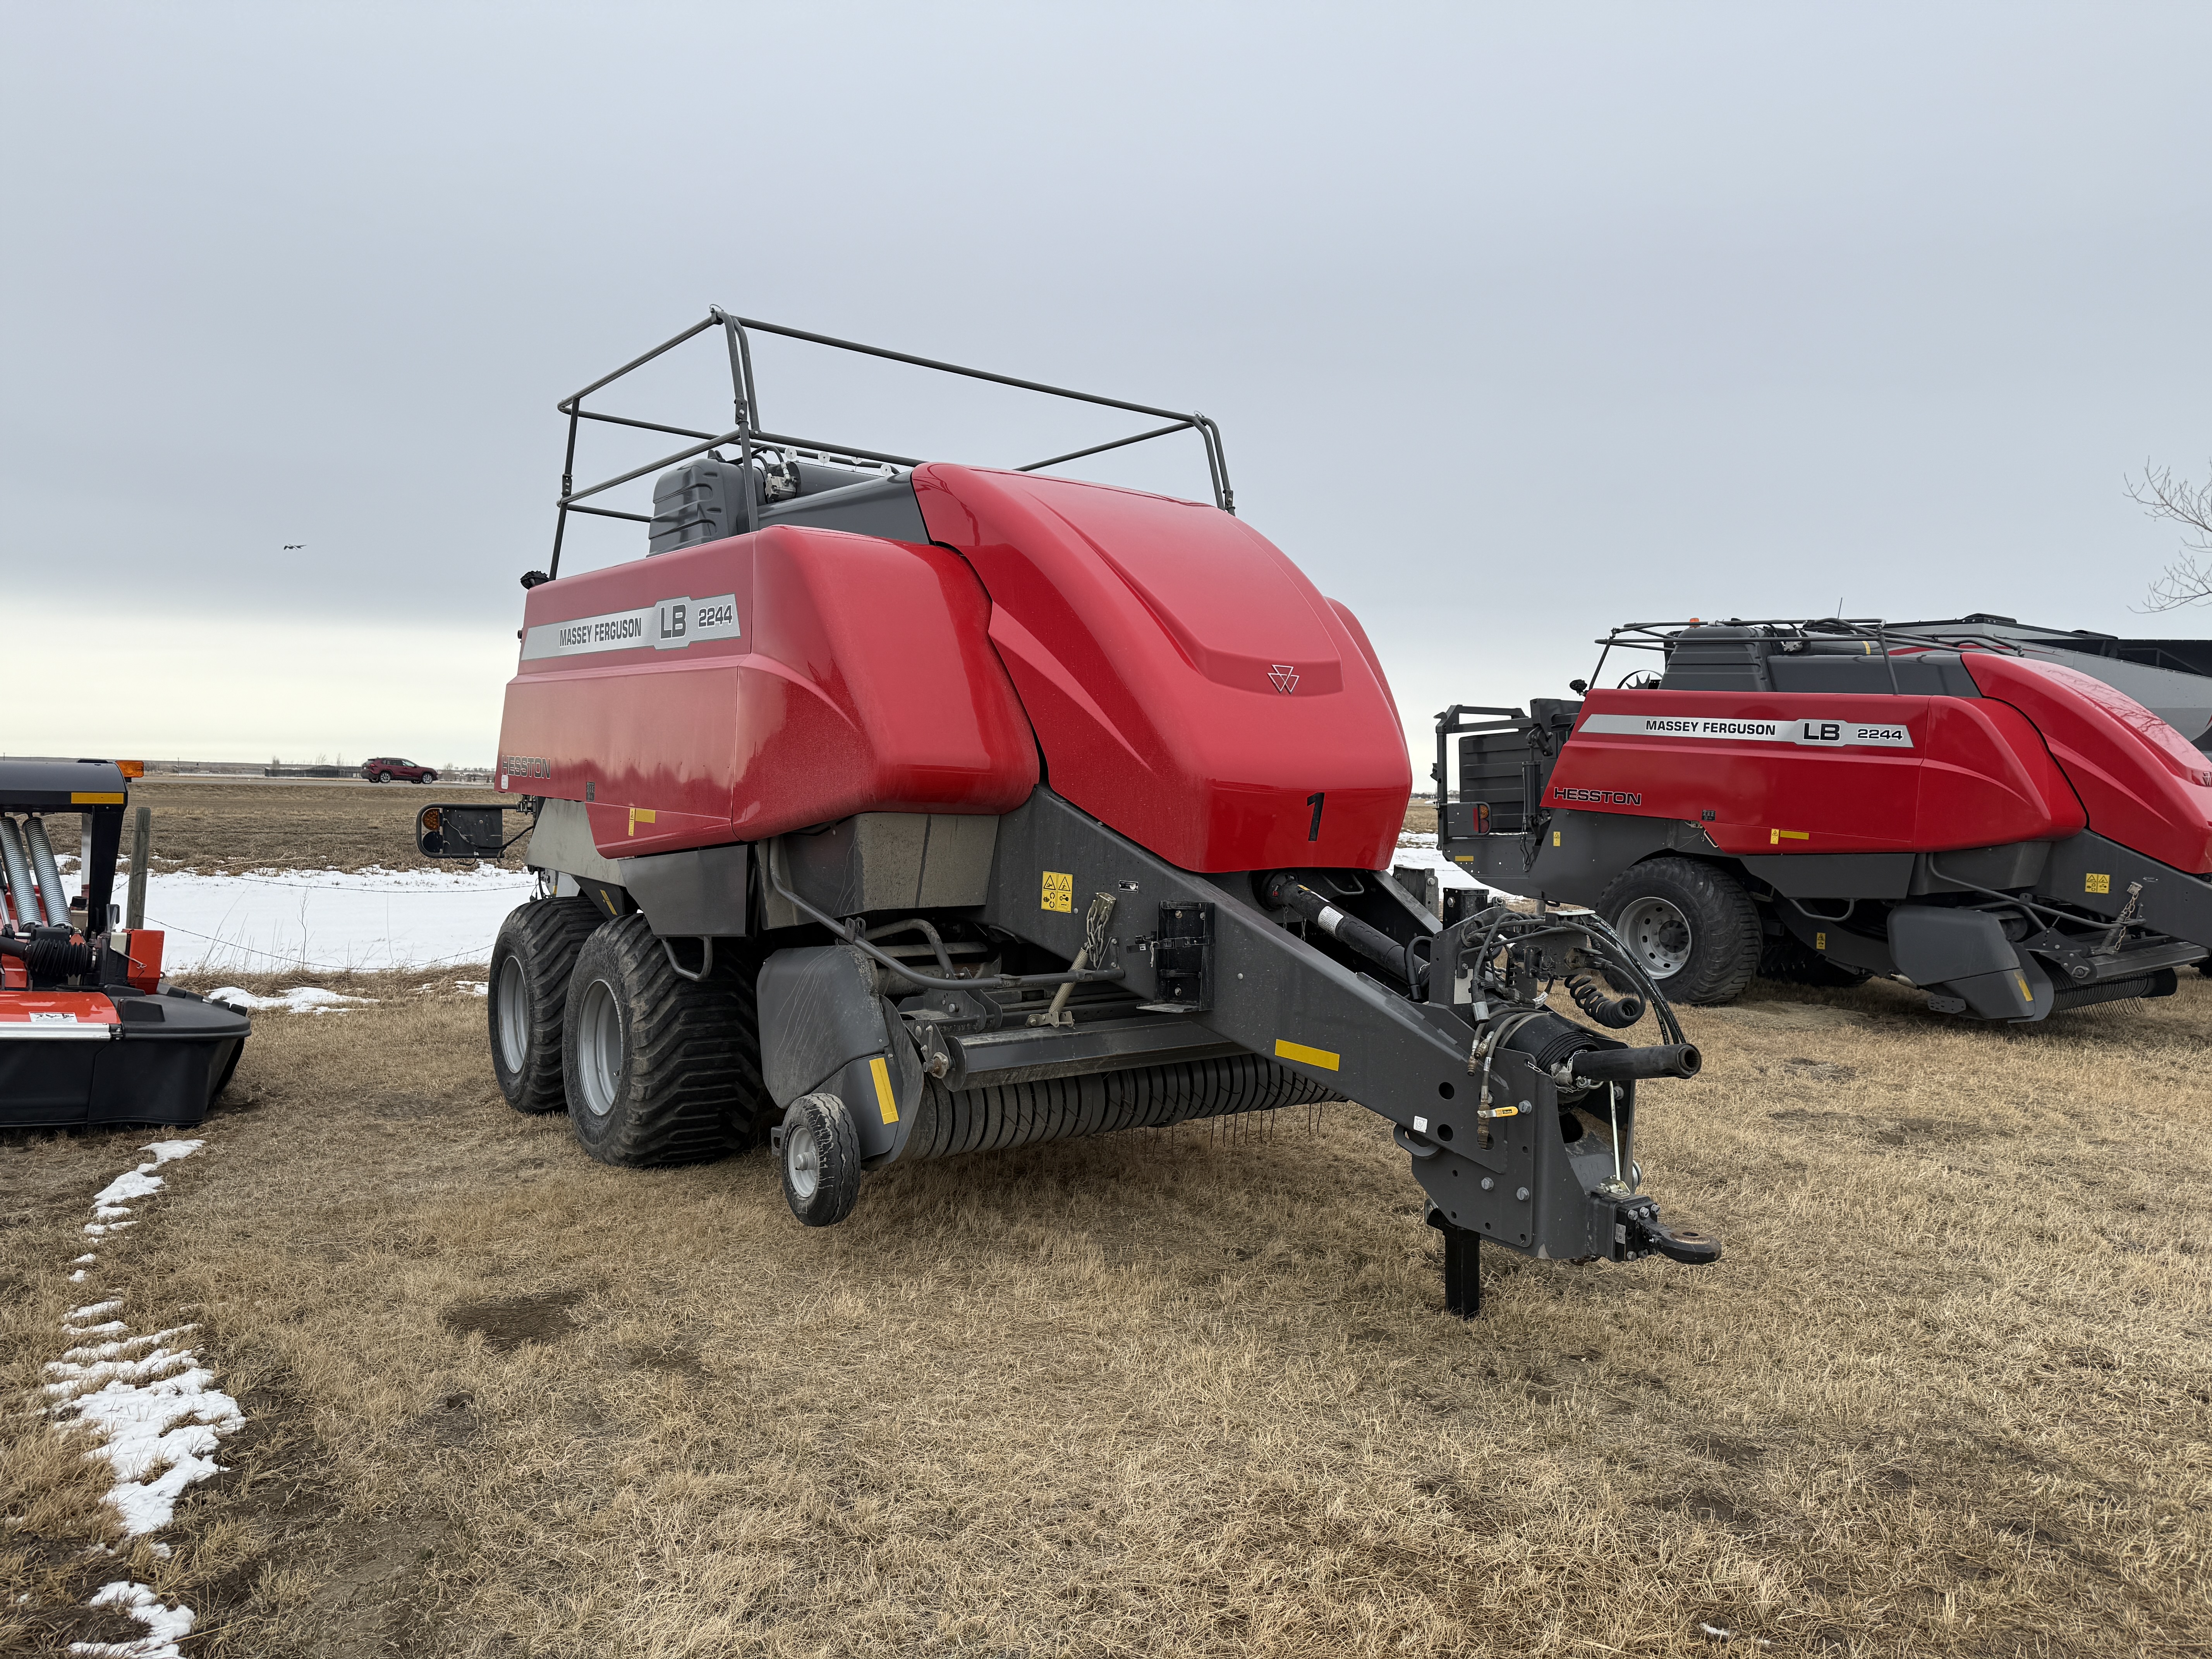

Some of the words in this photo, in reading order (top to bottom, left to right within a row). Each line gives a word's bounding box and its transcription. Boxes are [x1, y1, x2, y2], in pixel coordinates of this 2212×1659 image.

[559, 625, 592, 647] MASSEY
[594, 618, 642, 642] FERGUSON
[660, 604, 687, 639] LB
[698, 605, 732, 628] 2244
[1646, 720, 1699, 732] MASSEY
[1703, 722, 1776, 735] FERGUSON
[1803, 723, 1840, 740] LB
[1858, 728, 1903, 740] 2244
[501, 755, 551, 779] HESSTON
[1554, 787, 1641, 805] HESSTON
[1307, 792, 1325, 841] 1
